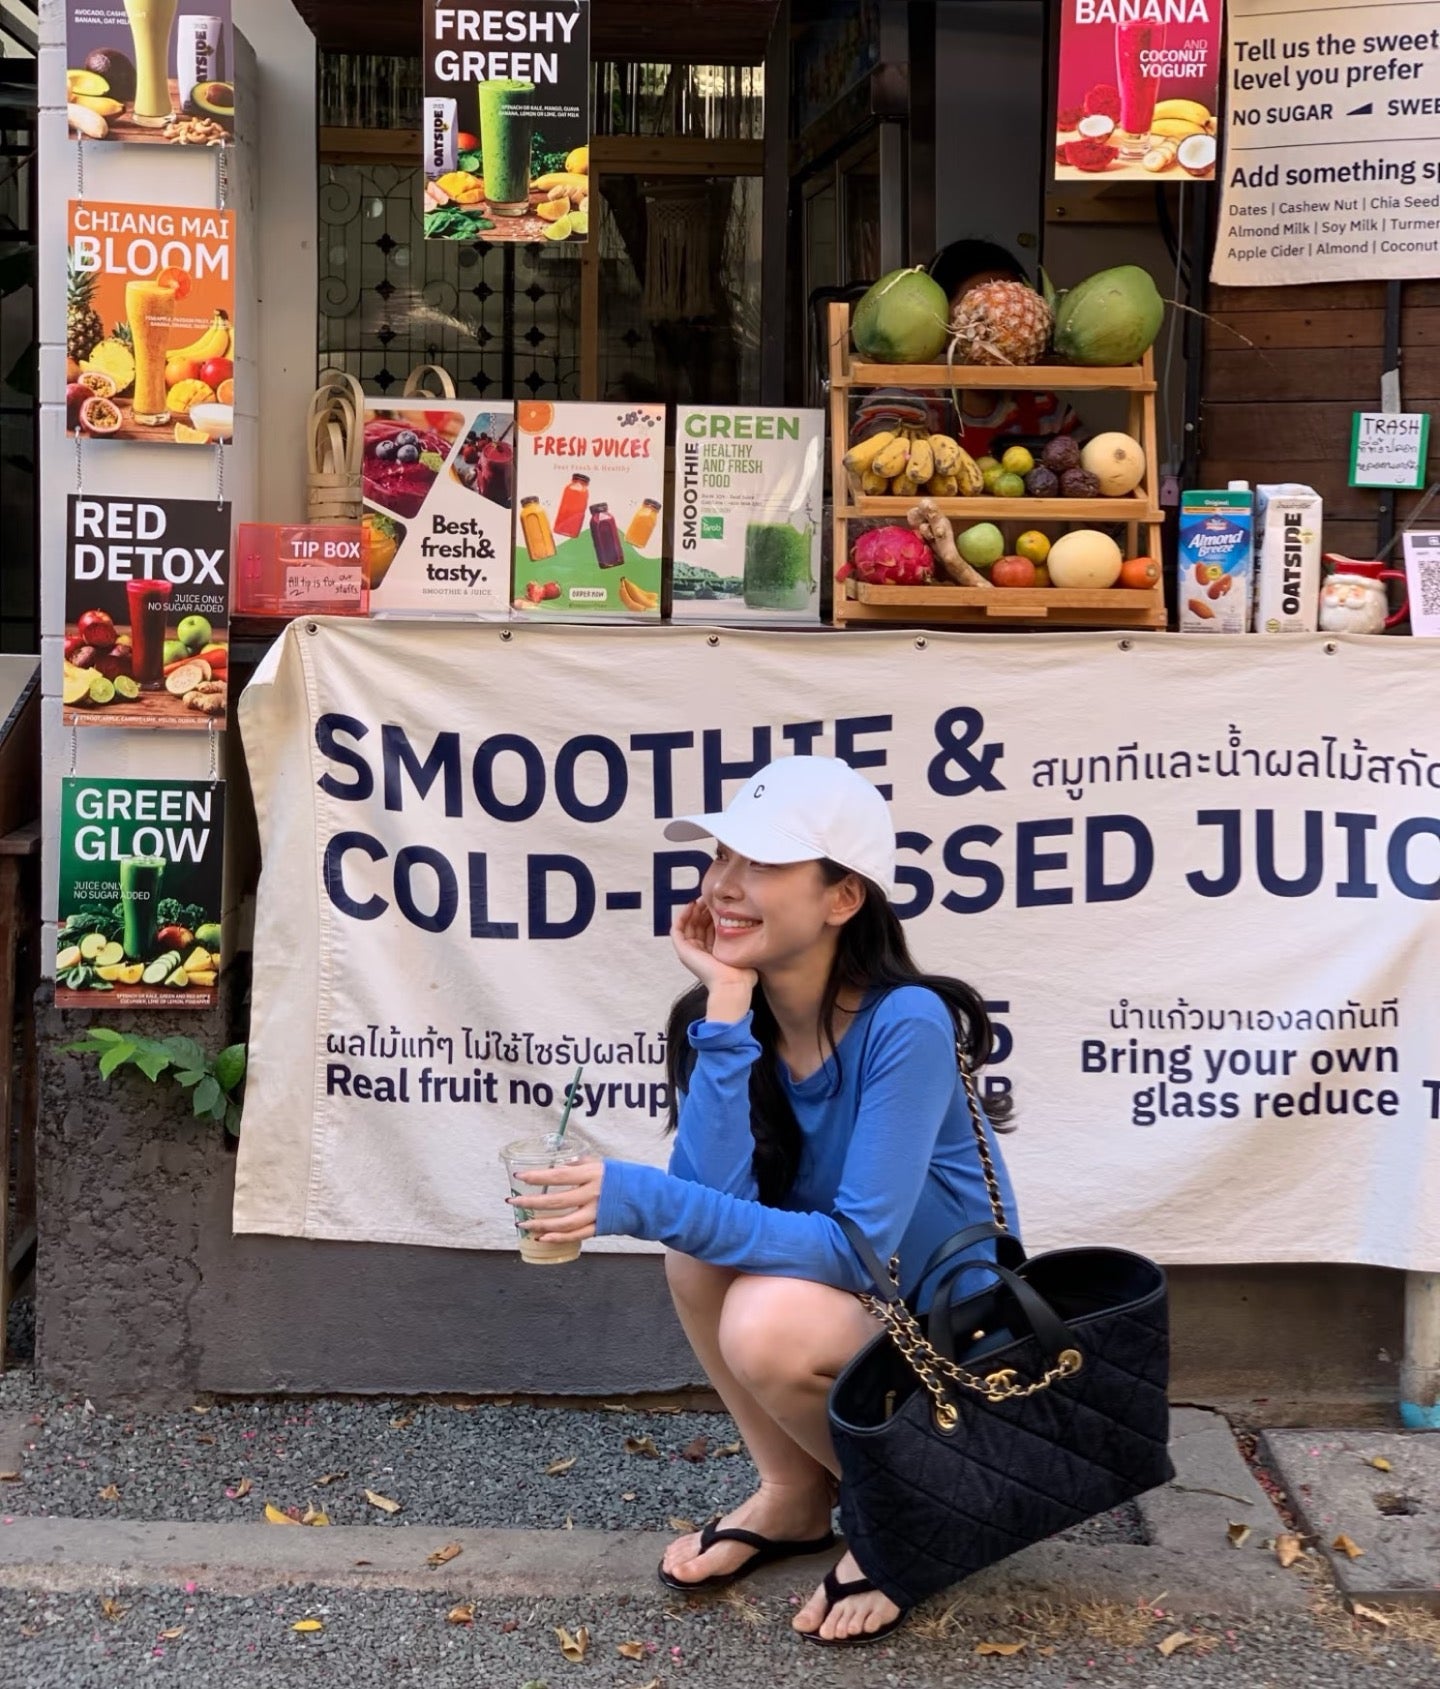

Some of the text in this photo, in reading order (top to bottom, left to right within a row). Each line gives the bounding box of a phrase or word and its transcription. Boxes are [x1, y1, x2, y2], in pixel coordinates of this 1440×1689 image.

[106, 10, 128, 18] CASHE
[1075, 0, 1210, 24] BANANA
[435, 9, 581, 43] FRESHY
[1183, 39, 1208, 49] AND
[1234, 29, 1440, 62] Tell us the sweet
[195, 31, 208, 82] ATSIDE
[434, 50, 559, 84] GREEN
[1139, 50, 1208, 63] COCONUT
[1139, 64, 1208, 78] YOGURT
[1233, 58, 1424, 91] level you prefer
[1233, 109, 1261, 126] NO
[1266, 104, 1333, 124] SUGAR
[433, 110, 444, 167] OATSIDE
[1230, 158, 1440, 188] Add something s
[1229, 203, 1268, 216] Dates
[1279, 201, 1330, 214] Cashew
[1334, 199, 1358, 211] Nut
[1370, 196, 1400, 209] Chia
[1404, 195, 1440, 208] Seed
[74, 209, 229, 240] CHIANG MAI
[1228, 224, 1280, 238] Almond
[1283, 222, 1310, 235] Milk
[1321, 221, 1346, 235] Soy
[1350, 218, 1378, 232] Milk
[74, 235, 230, 281] BLOOM
[1227, 247, 1267, 261] Apple
[1271, 244, 1304, 258] Cider
[1316, 241, 1369, 255] Almond
[1380, 239, 1438, 253] Coconut
[684, 413, 800, 441] GREEN
[1363, 417, 1419, 436] TRASH
[533, 435, 651, 458] FRESH JUICES
[703, 443, 753, 458] HEALTHY
[702, 459, 763, 474] AND FRESH
[702, 474, 730, 488] FOOD
[682, 442, 699, 550] SMOOTHIE
[75, 501, 167, 540] RED
[432, 514, 484, 538] Best,
[291, 541, 361, 559] TIP BOX
[1188, 530, 1245, 549] Almond
[1197, 544, 1235, 557] Breeze
[74, 543, 225, 586] DETOX
[426, 563, 488, 587] tasty.
[1282, 513, 1302, 615] OATSIDE
[288, 576, 299, 588] All
[300, 576, 312, 592] tip
[313, 578, 321, 588] is
[323, 576, 335, 587] for
[148, 602, 224, 613] NO SUGAR ADDED
[174, 593, 224, 604] JUICE ONLY
[927, 706, 1007, 797] &
[754, 784, 765, 799] C
[76, 788, 212, 823] GREEN
[75, 825, 211, 863] GLOW
[74, 881, 124, 891] JUICE ONLY
[324, 813, 1153, 940] COLD-PSSED
[74, 890, 150, 900] NO SUGAR ADDED
[1081, 1038, 1400, 1085] Bring your own
[326, 1063, 672, 1118] Real fruit no syrup
[1132, 1082, 1241, 1128] glass
[1253, 1081, 1401, 1120] reduce
